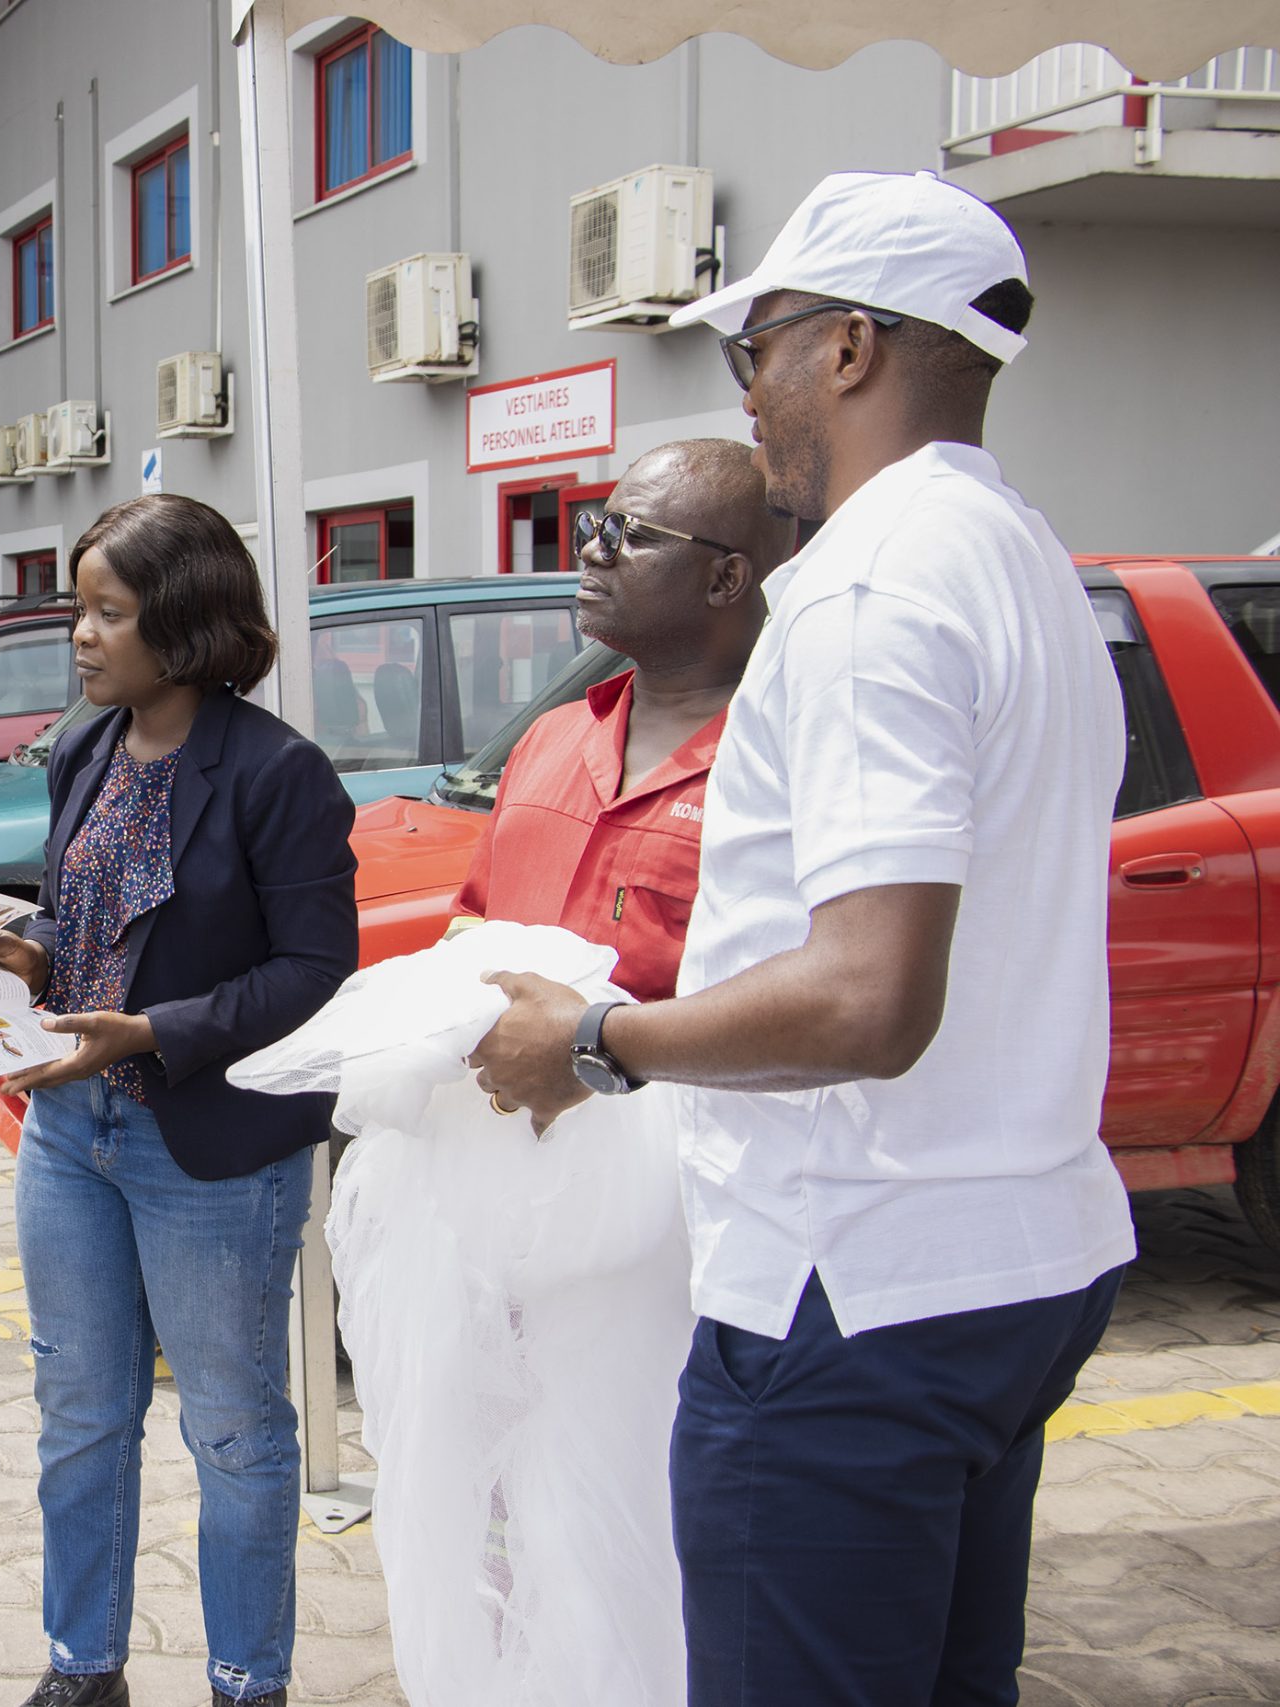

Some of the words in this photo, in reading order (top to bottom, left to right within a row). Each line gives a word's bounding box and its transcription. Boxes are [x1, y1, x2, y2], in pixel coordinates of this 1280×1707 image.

[506, 387, 570, 416] VESTIAIRES
[483, 425, 547, 451] PERSONNEL
[550, 415, 596, 441] ATELIER
